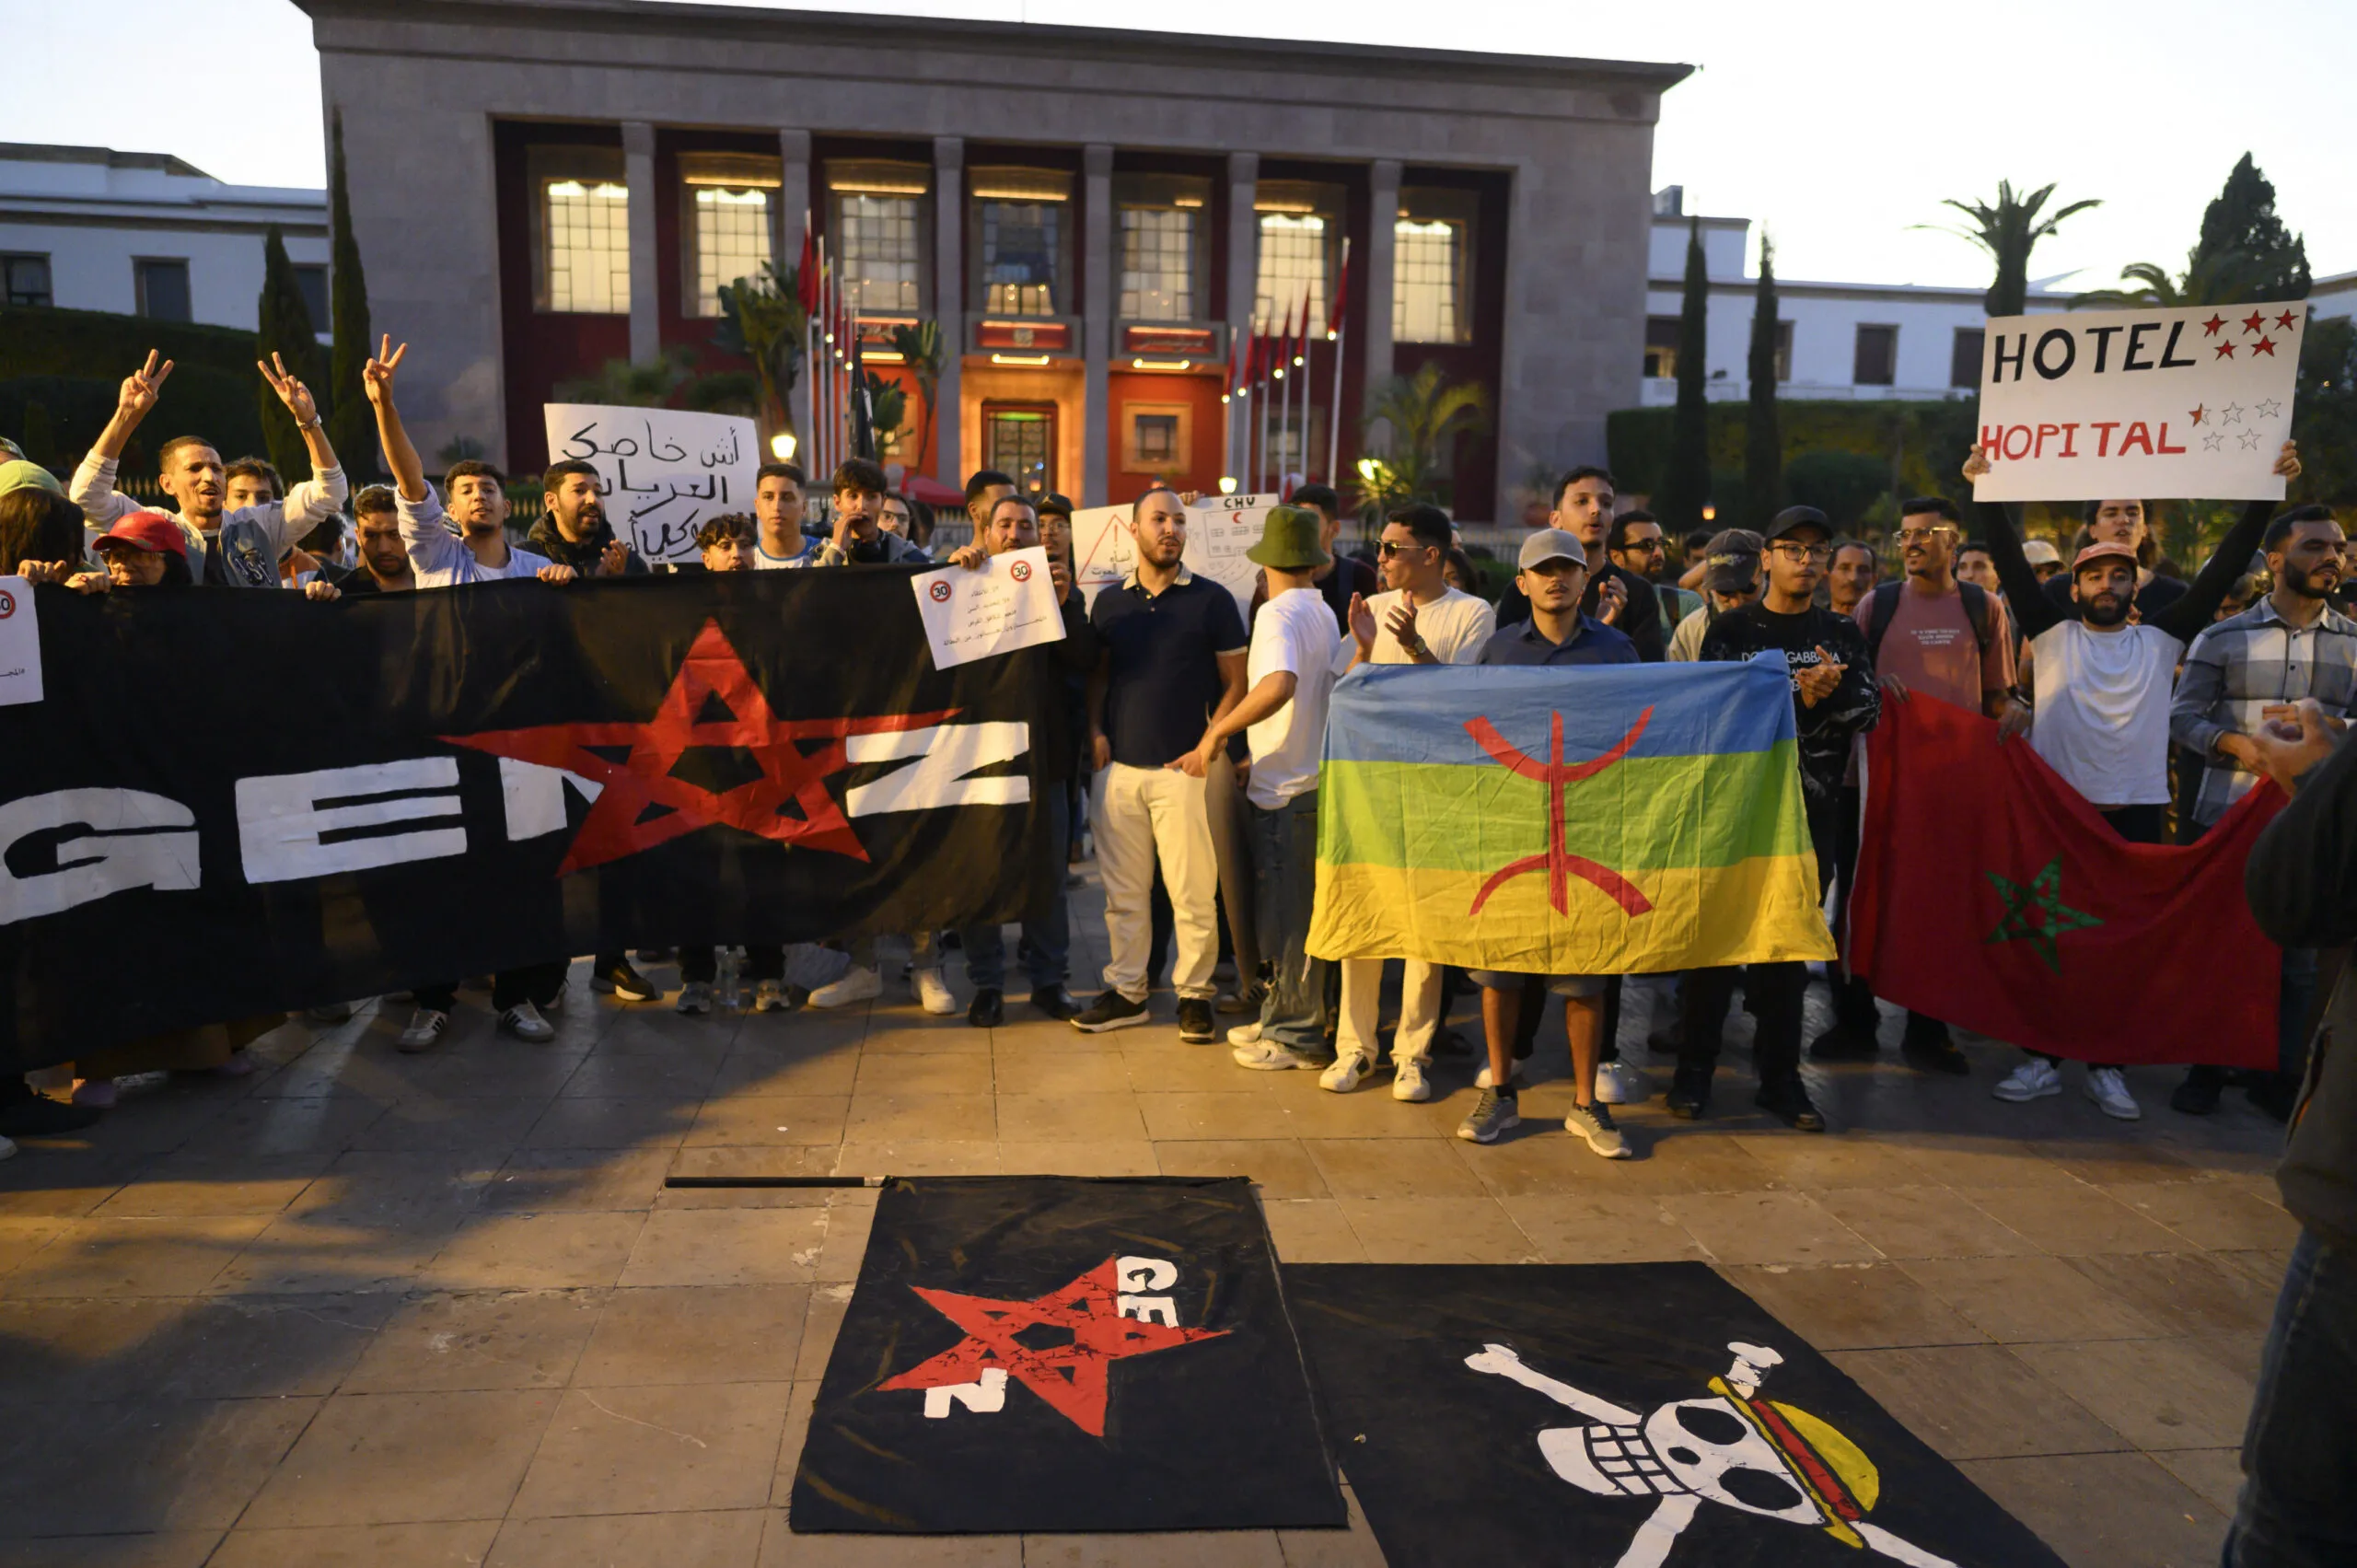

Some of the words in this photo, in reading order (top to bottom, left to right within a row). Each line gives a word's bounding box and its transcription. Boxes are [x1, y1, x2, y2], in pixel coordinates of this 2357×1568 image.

[1992, 320, 2197, 383] HOTEL
[562, 419, 687, 462] خاصك
[1981, 422, 2187, 460] HOPITAL
[1224, 496, 1256, 508] CHU
[1015, 565, 1028, 576] 30
[0, 598, 10, 610] 0
[934, 586, 947, 598] 30
[846, 722, 1029, 818] Z
